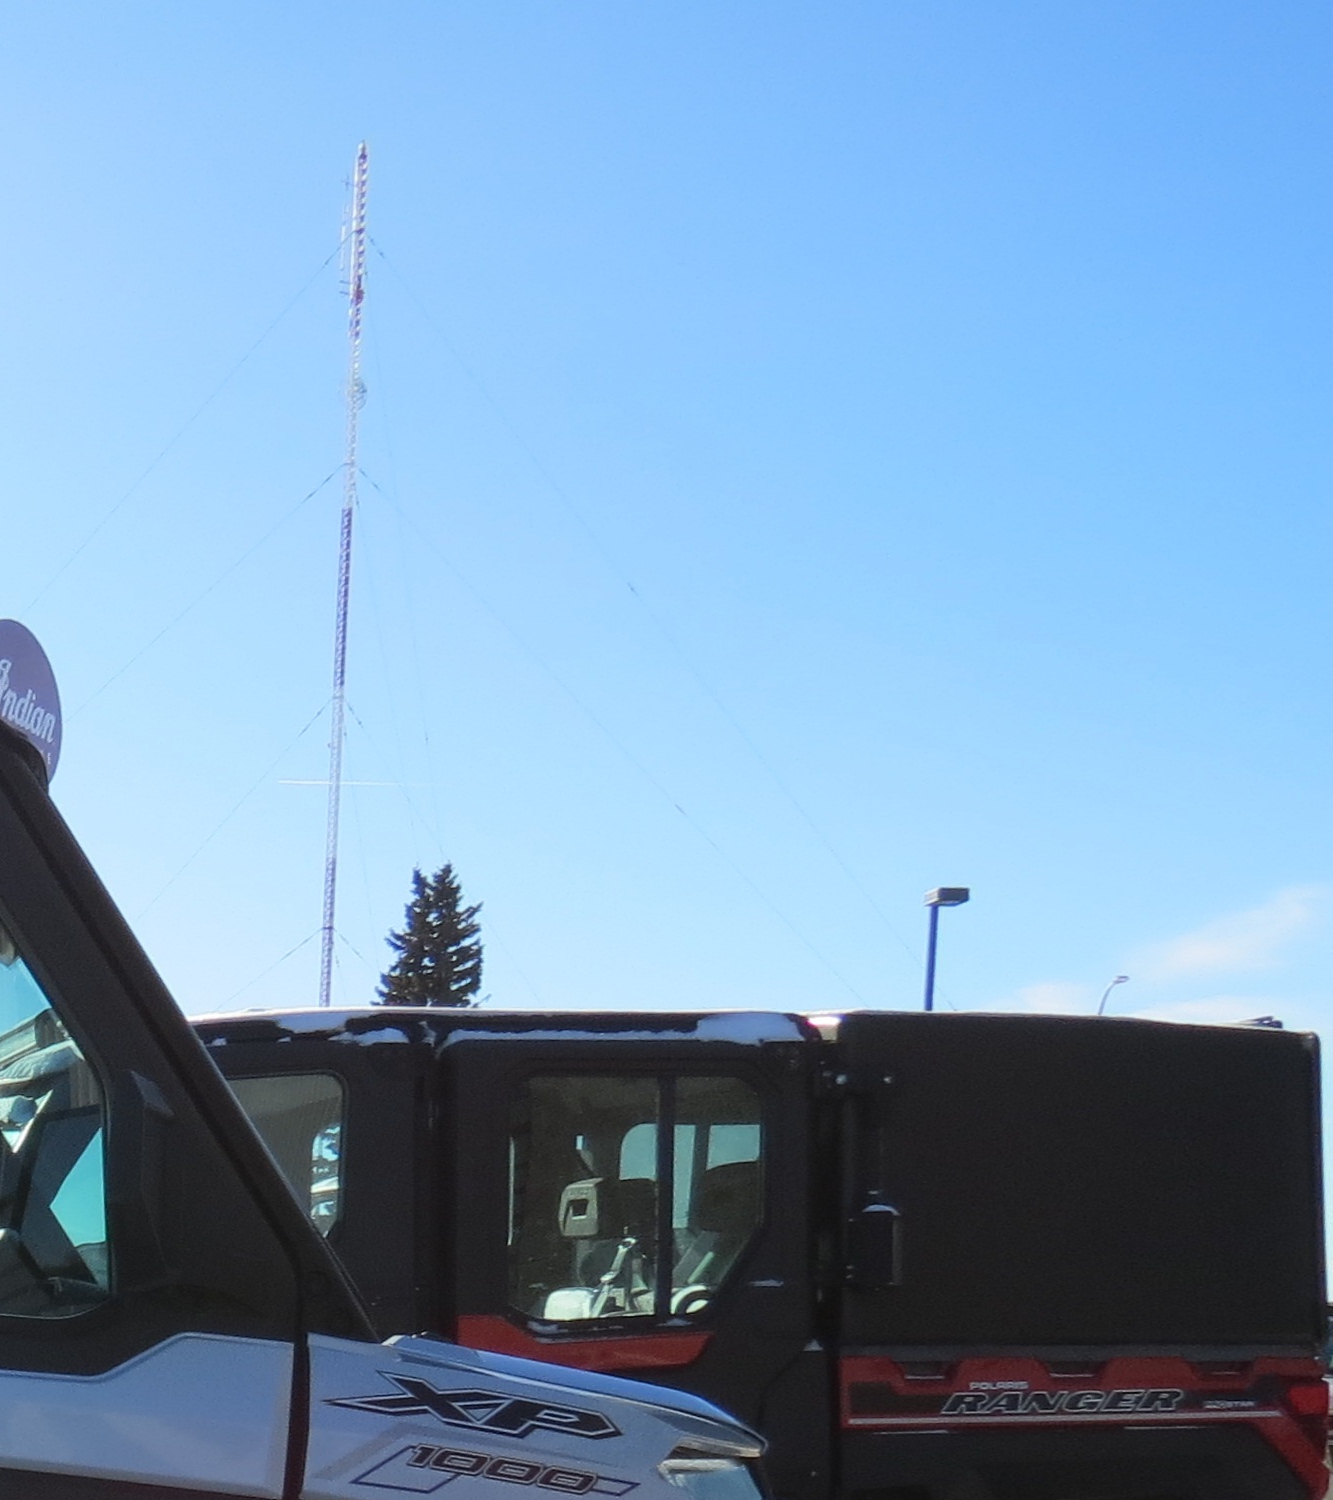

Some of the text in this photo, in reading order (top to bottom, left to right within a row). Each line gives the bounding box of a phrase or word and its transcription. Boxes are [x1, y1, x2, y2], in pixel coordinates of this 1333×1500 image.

[321, 1369, 624, 1441] XP
[940, 1388, 1185, 1416] RANGER
[969, 1381, 1030, 1391] POLARIS
[406, 1443, 598, 1494] 1000
